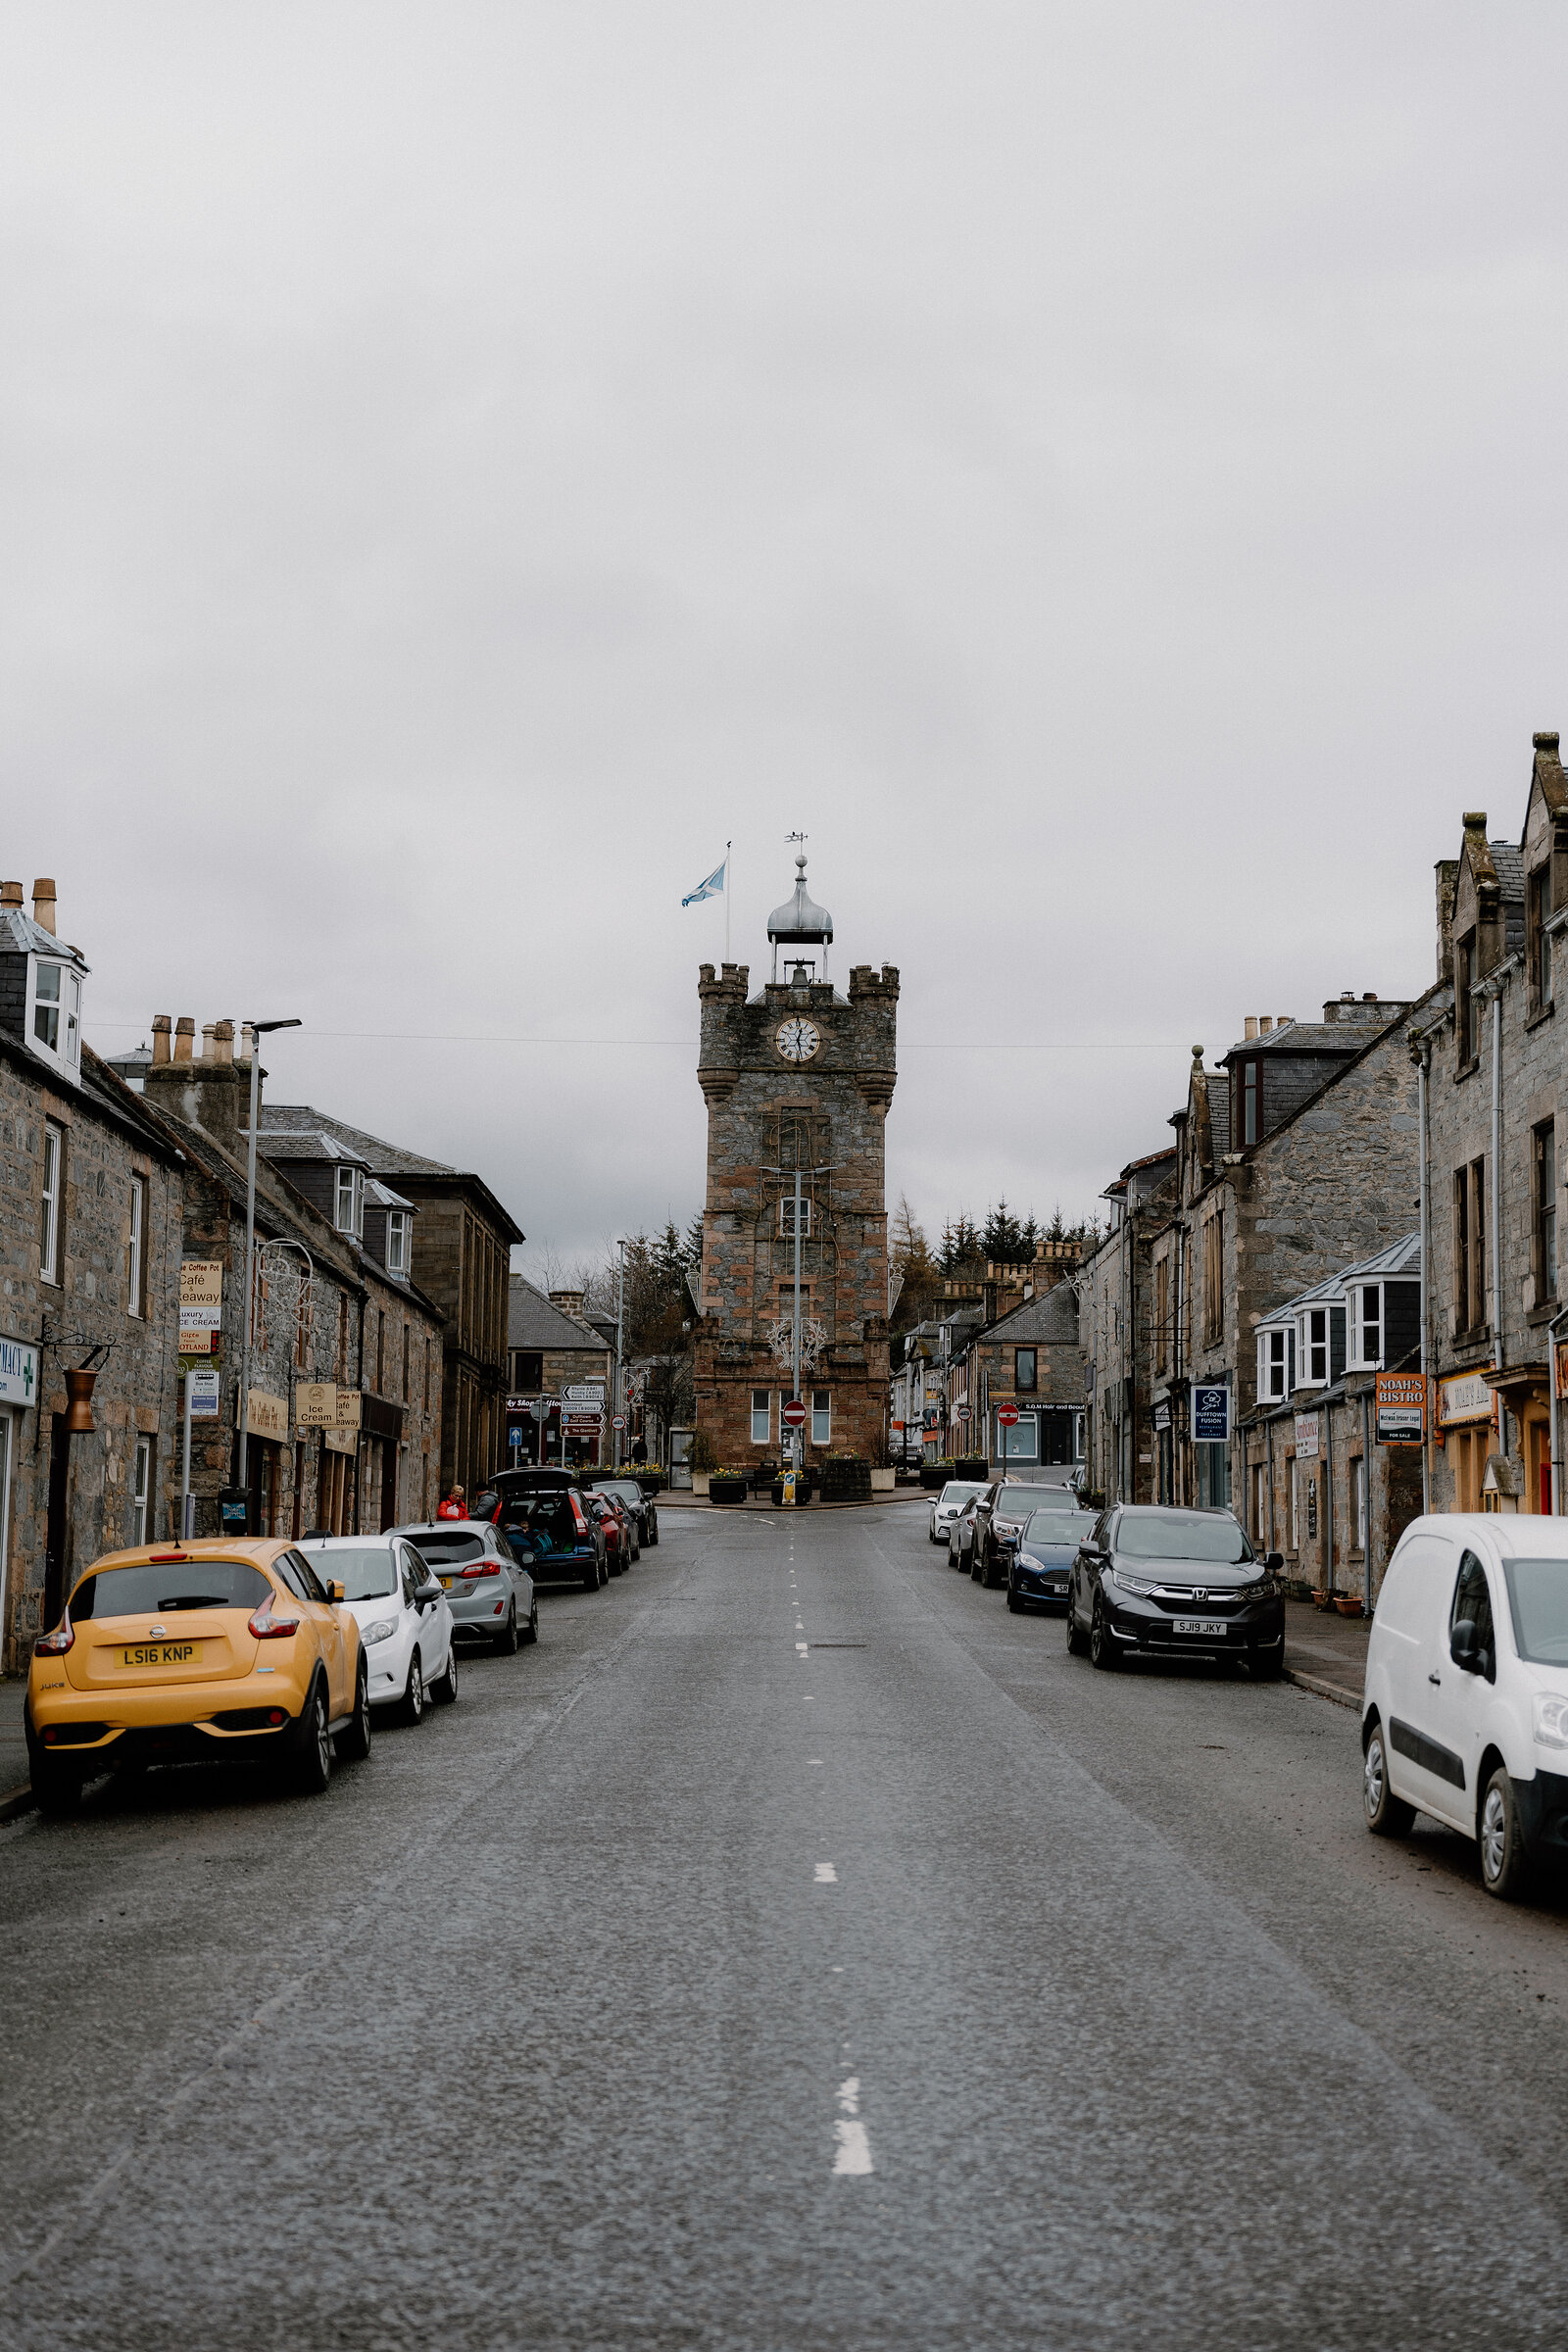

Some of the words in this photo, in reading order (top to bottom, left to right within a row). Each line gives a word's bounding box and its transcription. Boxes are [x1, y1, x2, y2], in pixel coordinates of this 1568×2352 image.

[180, 1274, 205, 1285] Café
[0, 1343, 23, 1376] MACY
[1380, 1380, 1423, 1391] NOAH'S
[1379, 1392, 1424, 1402] BISTRO
[1179, 1622, 1200, 1632] SJ19
[1202, 1623, 1221, 1633] JKY
[124, 1648, 158, 1665] LS16
[163, 1646, 193, 1662] KNP
